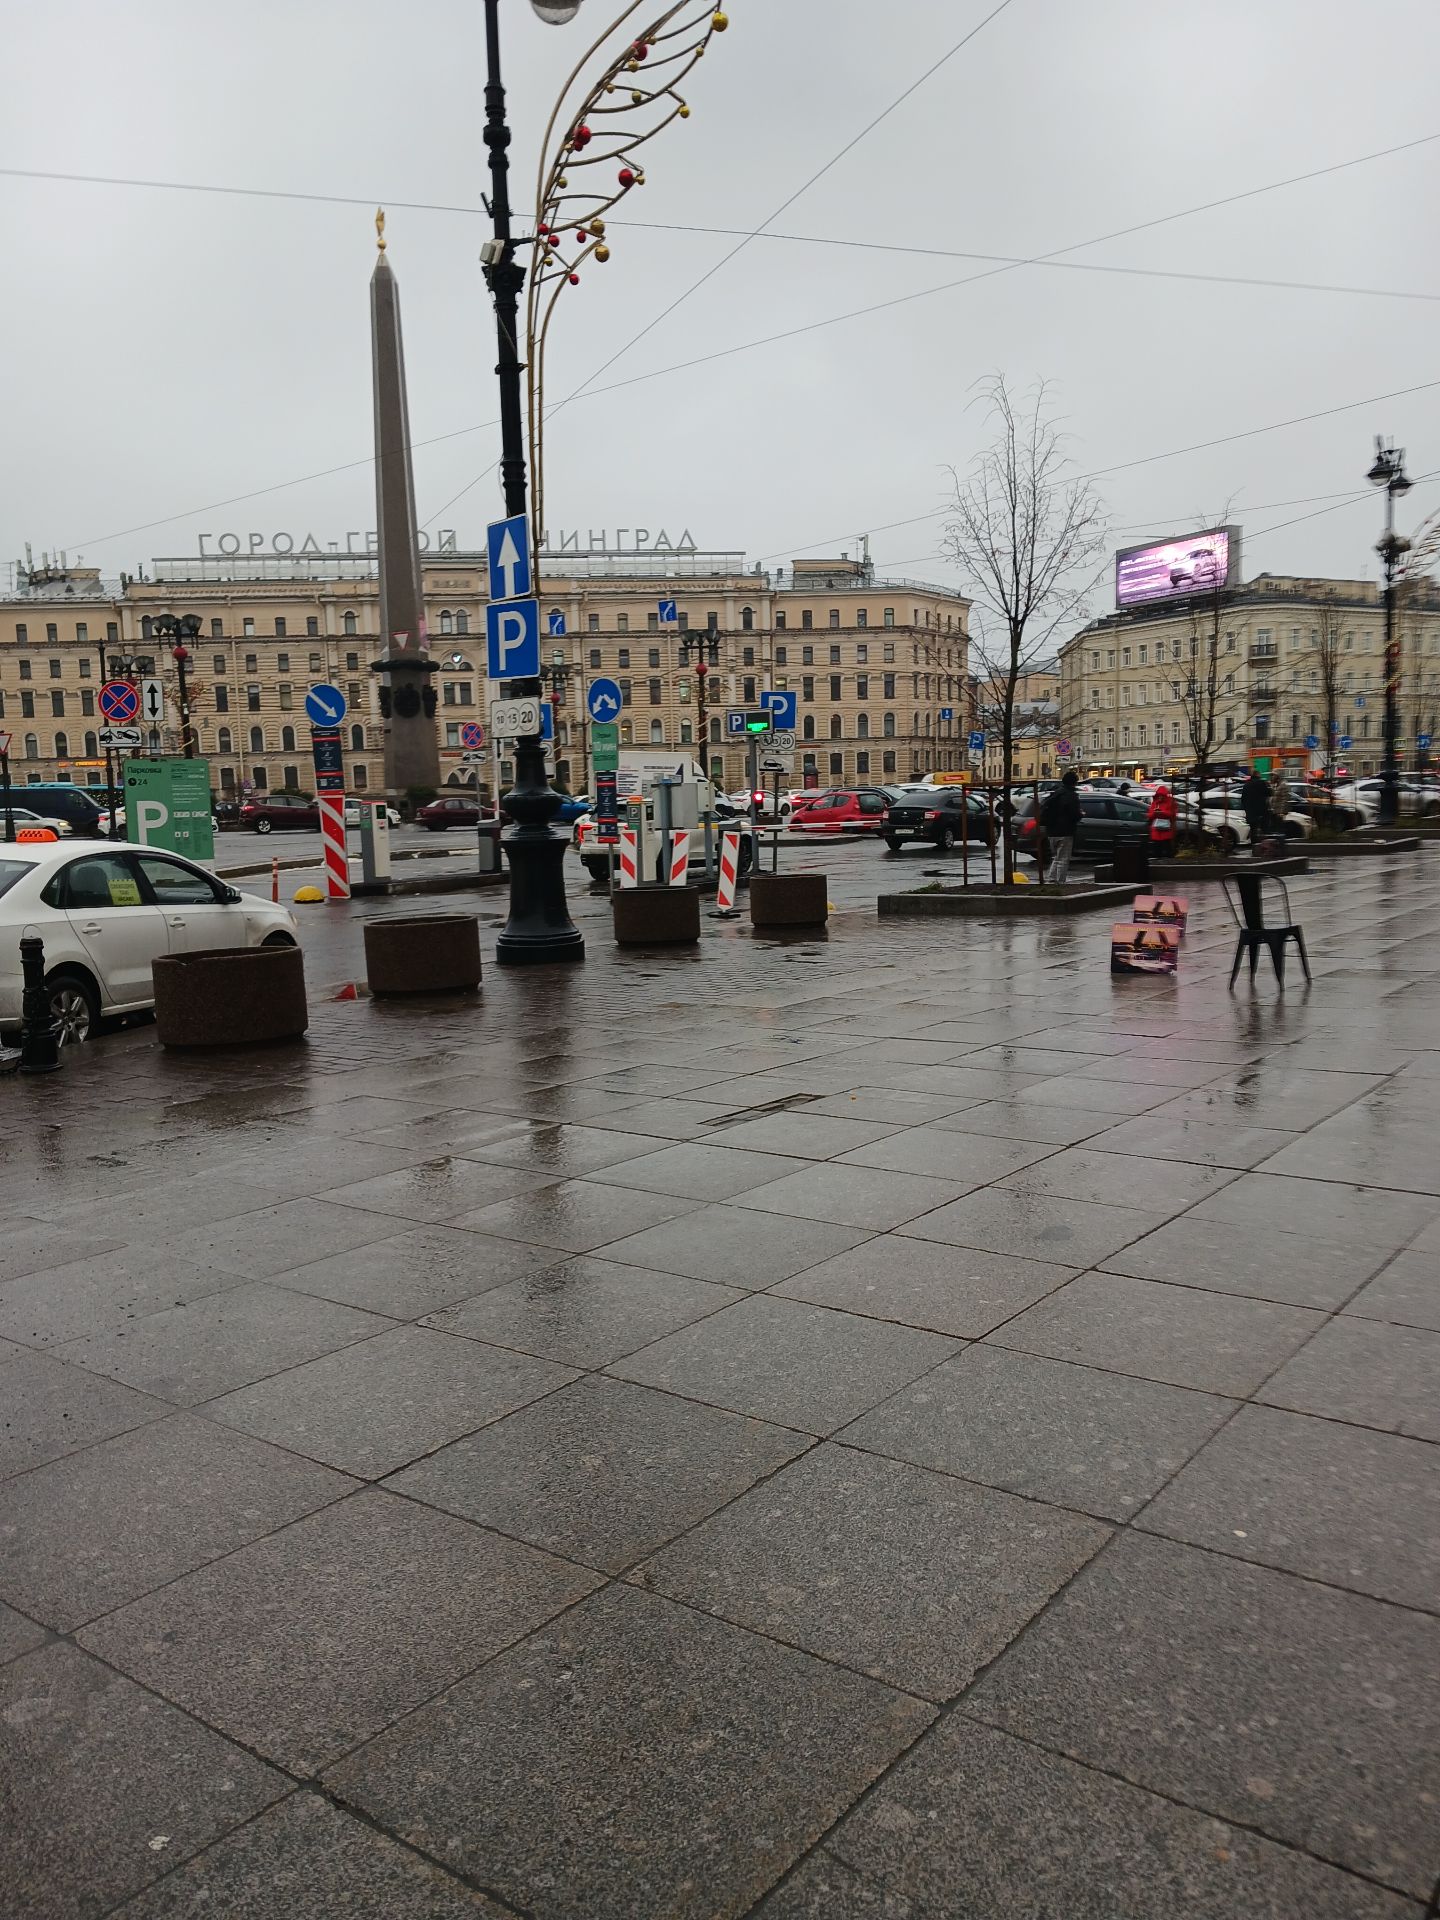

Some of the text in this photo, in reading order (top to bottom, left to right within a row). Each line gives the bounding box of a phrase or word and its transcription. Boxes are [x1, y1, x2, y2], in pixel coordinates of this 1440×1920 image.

[198, 527, 698, 556] ГОРОД-ГЕОЙ ИНГРАД
[498, 610, 527, 671] P
[507, 713, 517, 724] 15
[521, 711, 533, 723] 20
[731, 715, 742, 731] P
[782, 737, 791, 745] 20
[127, 766, 162, 775] Парковка
[137, 778, 148, 786] 24
[136, 800, 169, 846] P
